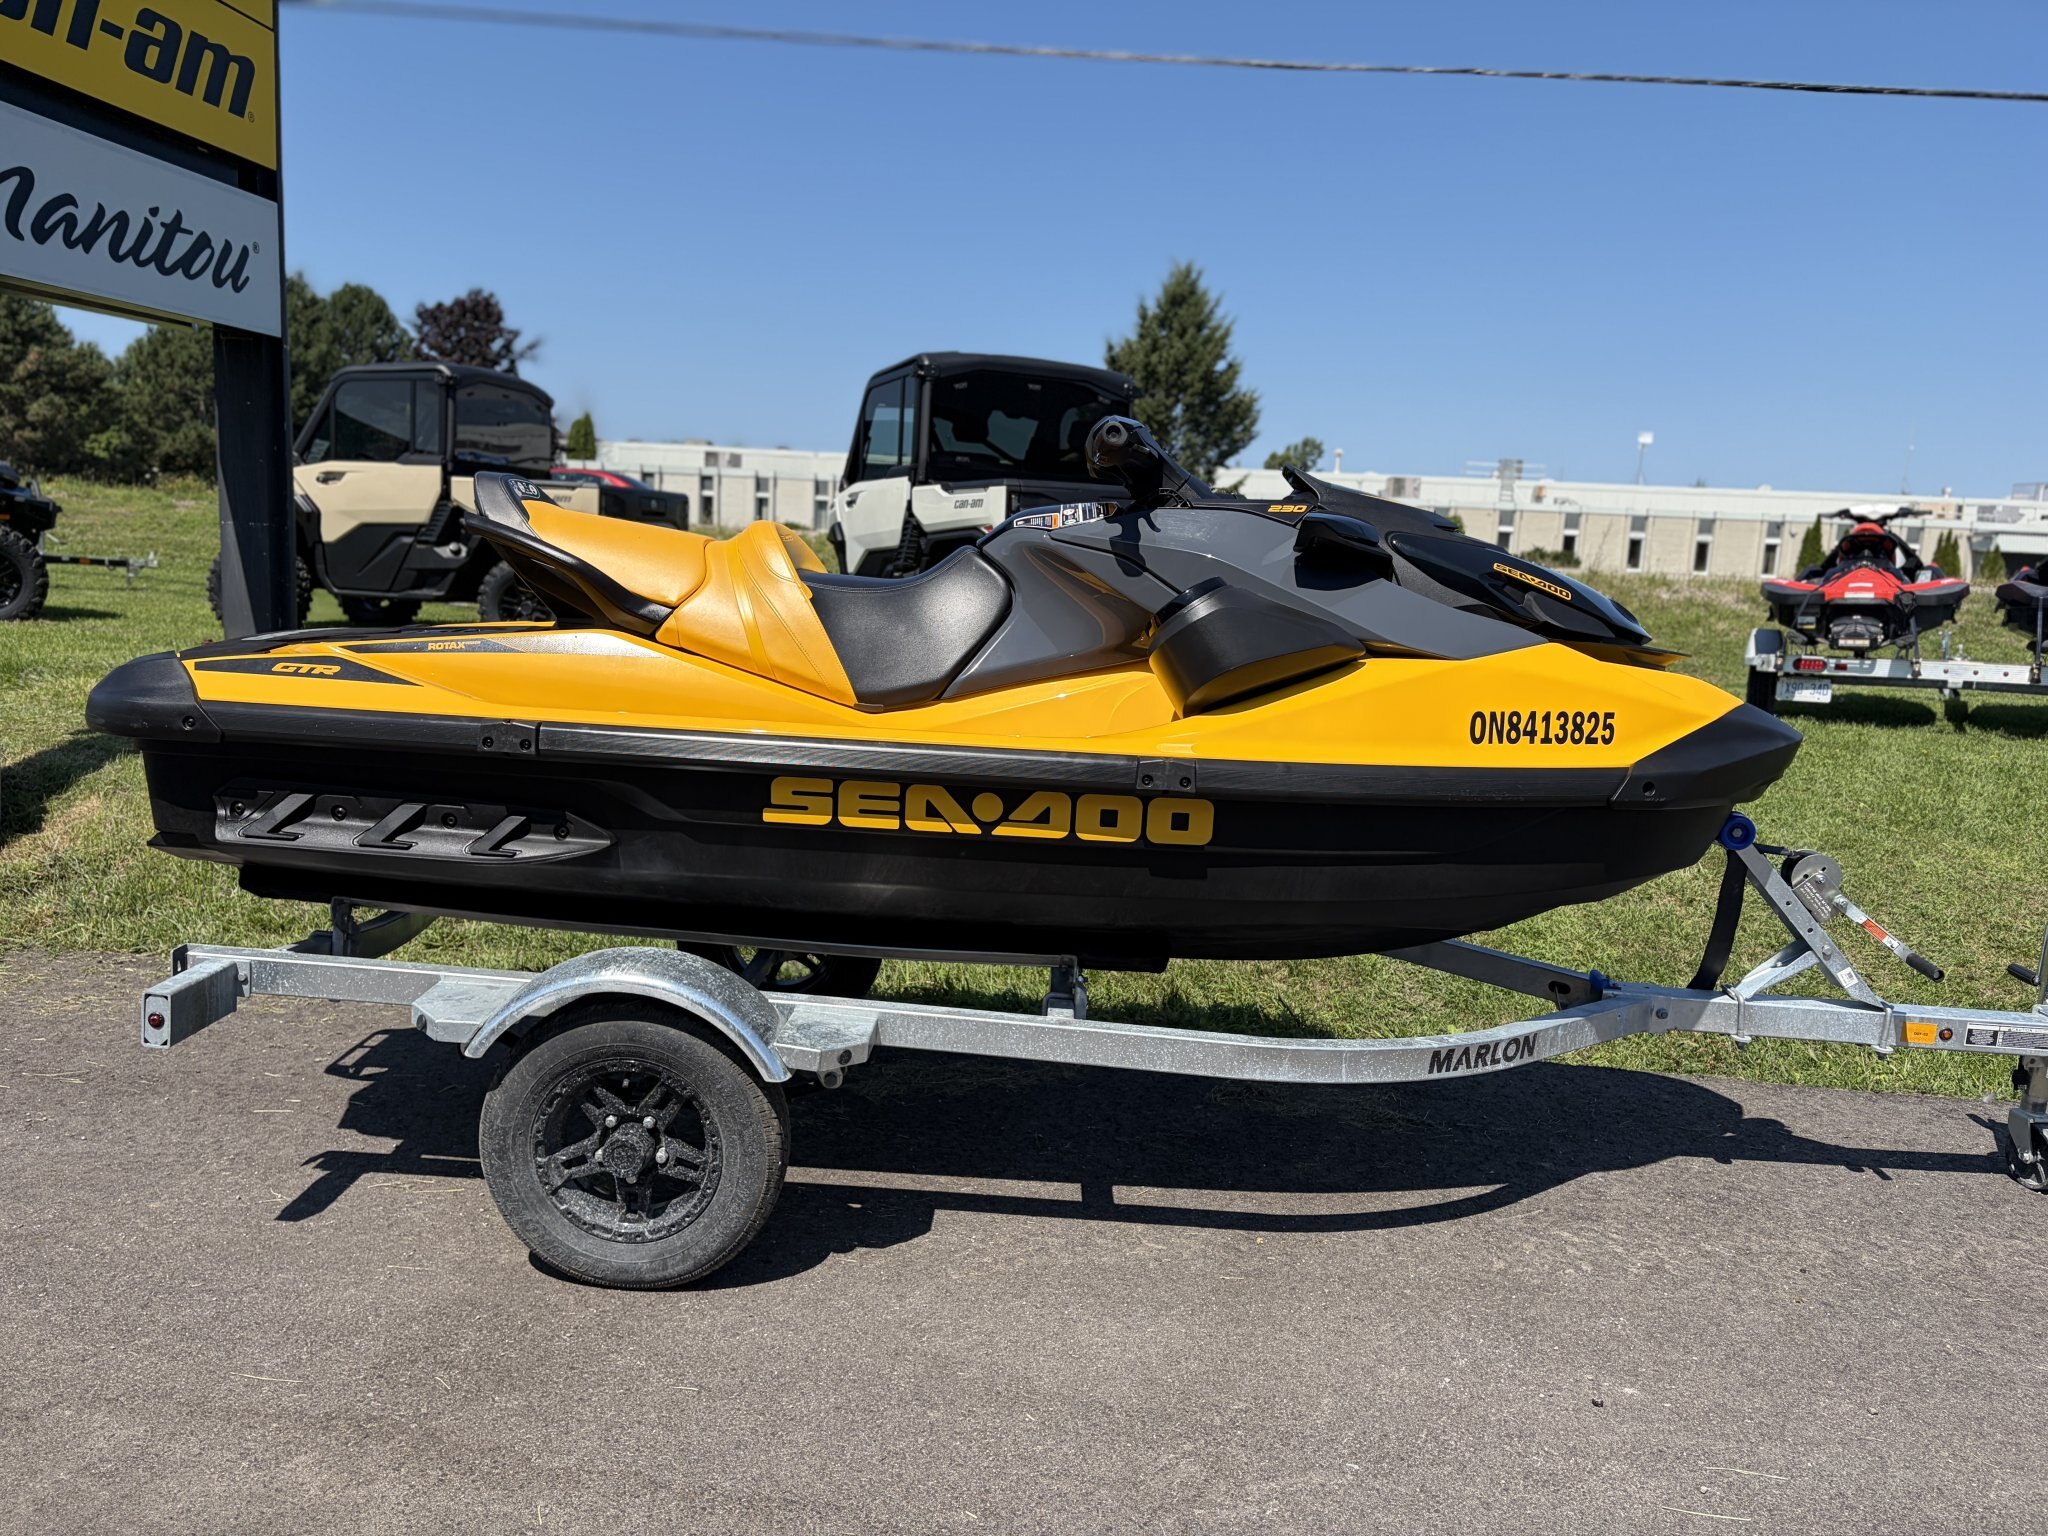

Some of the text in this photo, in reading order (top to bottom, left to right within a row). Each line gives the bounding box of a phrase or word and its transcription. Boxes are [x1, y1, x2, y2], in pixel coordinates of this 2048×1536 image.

[953, 498, 984, 510] can-am
[1267, 504, 1308, 513] 230
[427, 641, 466, 650] ROTAX
[271, 662, 341, 676] GTR
[1469, 710, 1616, 745] ON8413825
[1428, 1033, 1538, 1074] MARLON
